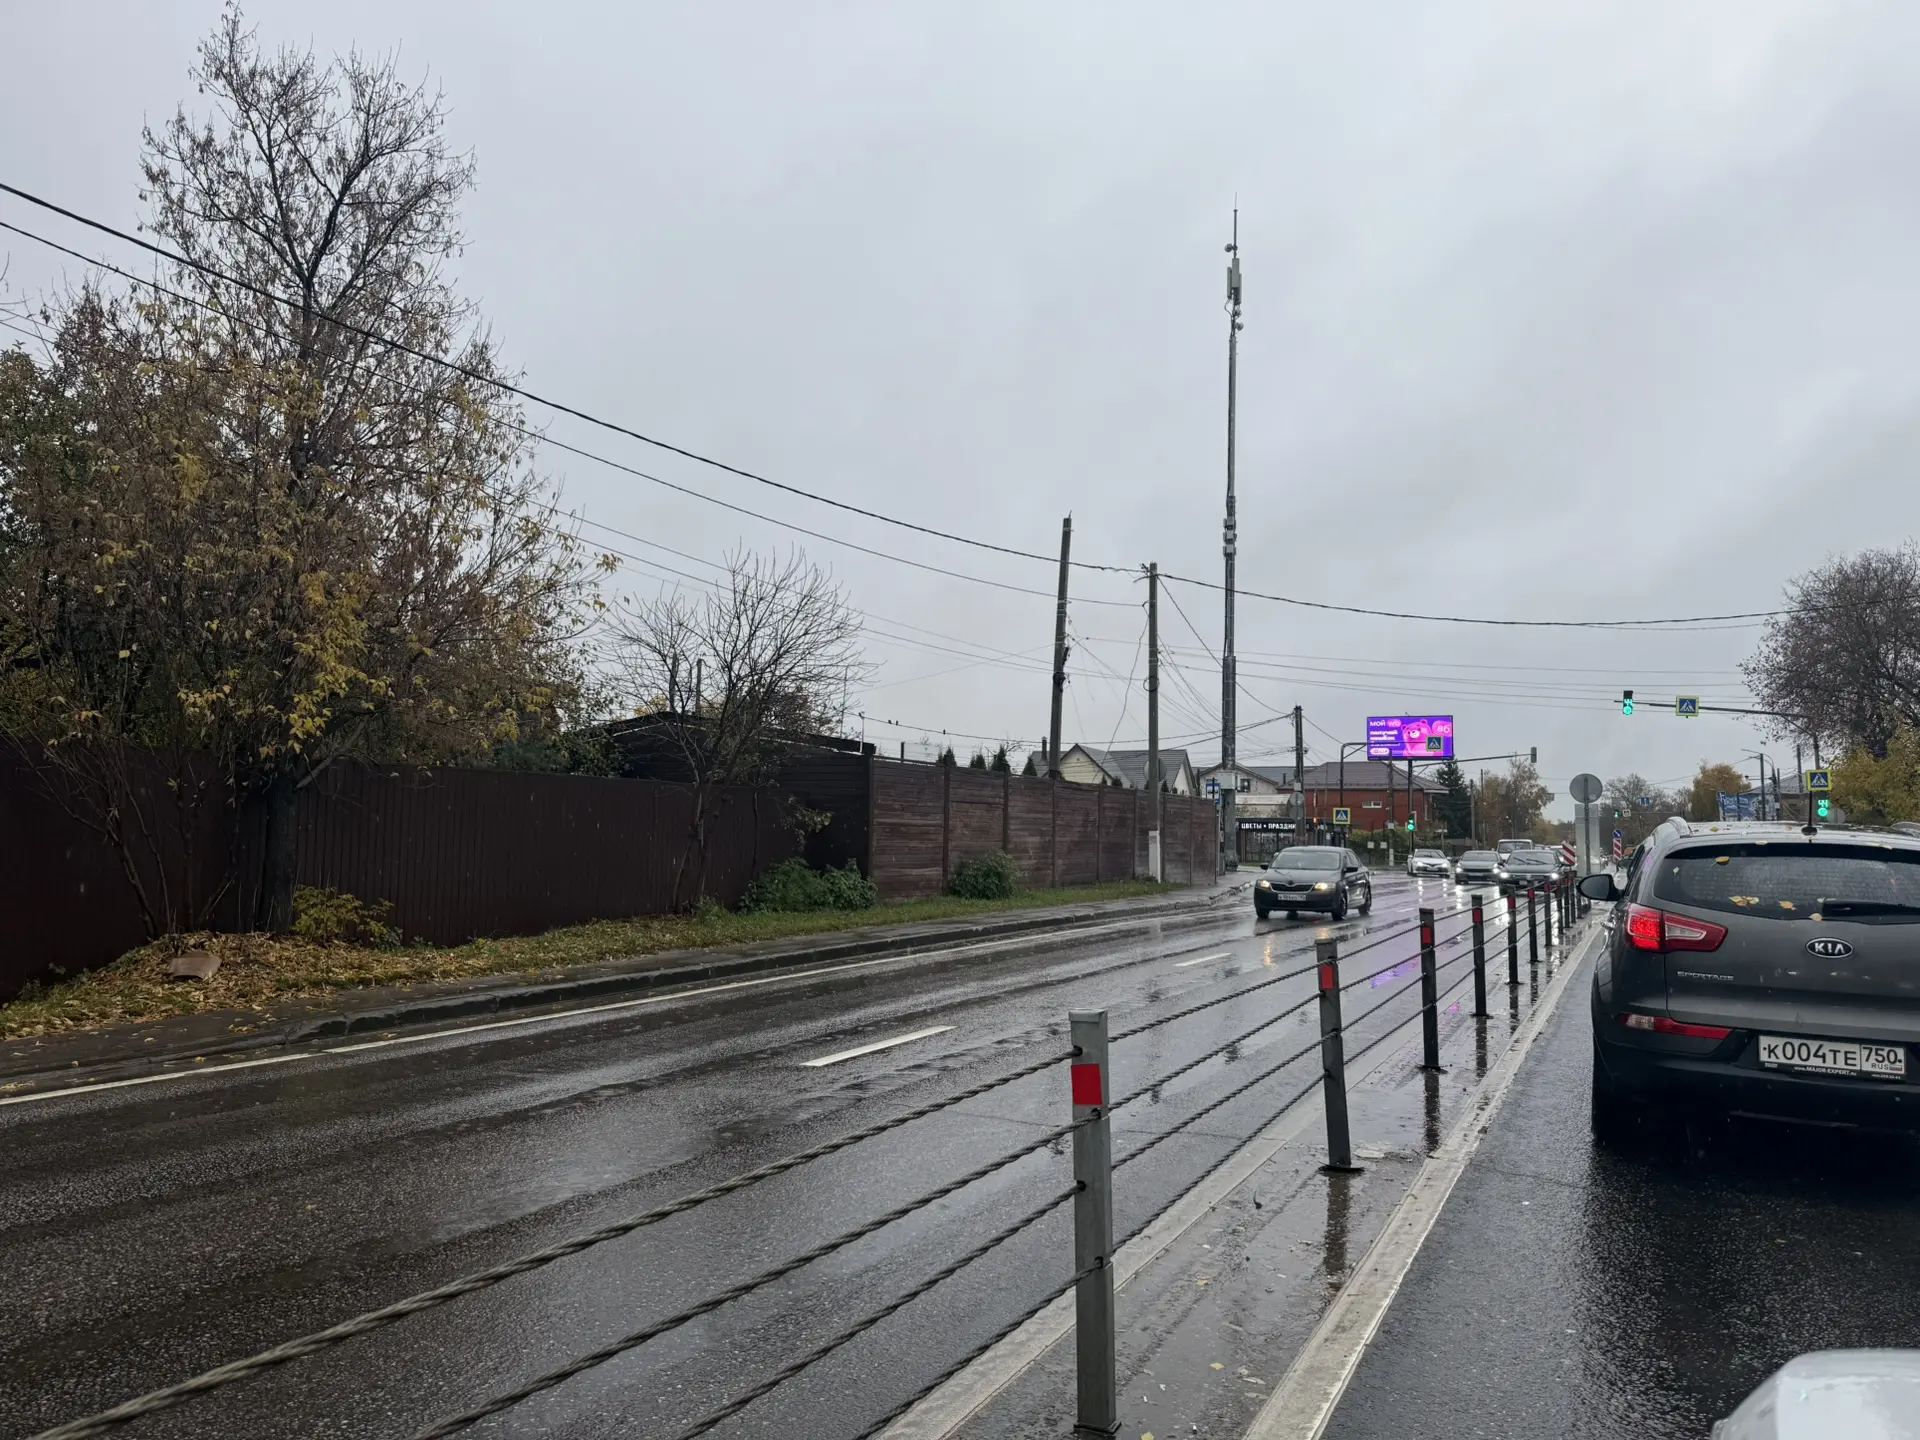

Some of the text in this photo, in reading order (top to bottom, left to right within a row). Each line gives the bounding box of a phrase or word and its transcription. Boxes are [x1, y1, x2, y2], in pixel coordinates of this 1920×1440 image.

[1241, 822, 1261, 830] ЦВЕТЫ
[1268, 822, 1296, 830] ПРАЗДНИ
[1814, 942, 1845, 954] KIA
[1677, 970, 1735, 981] SPORTAGE
[1862, 1046, 1898, 1064] 750
